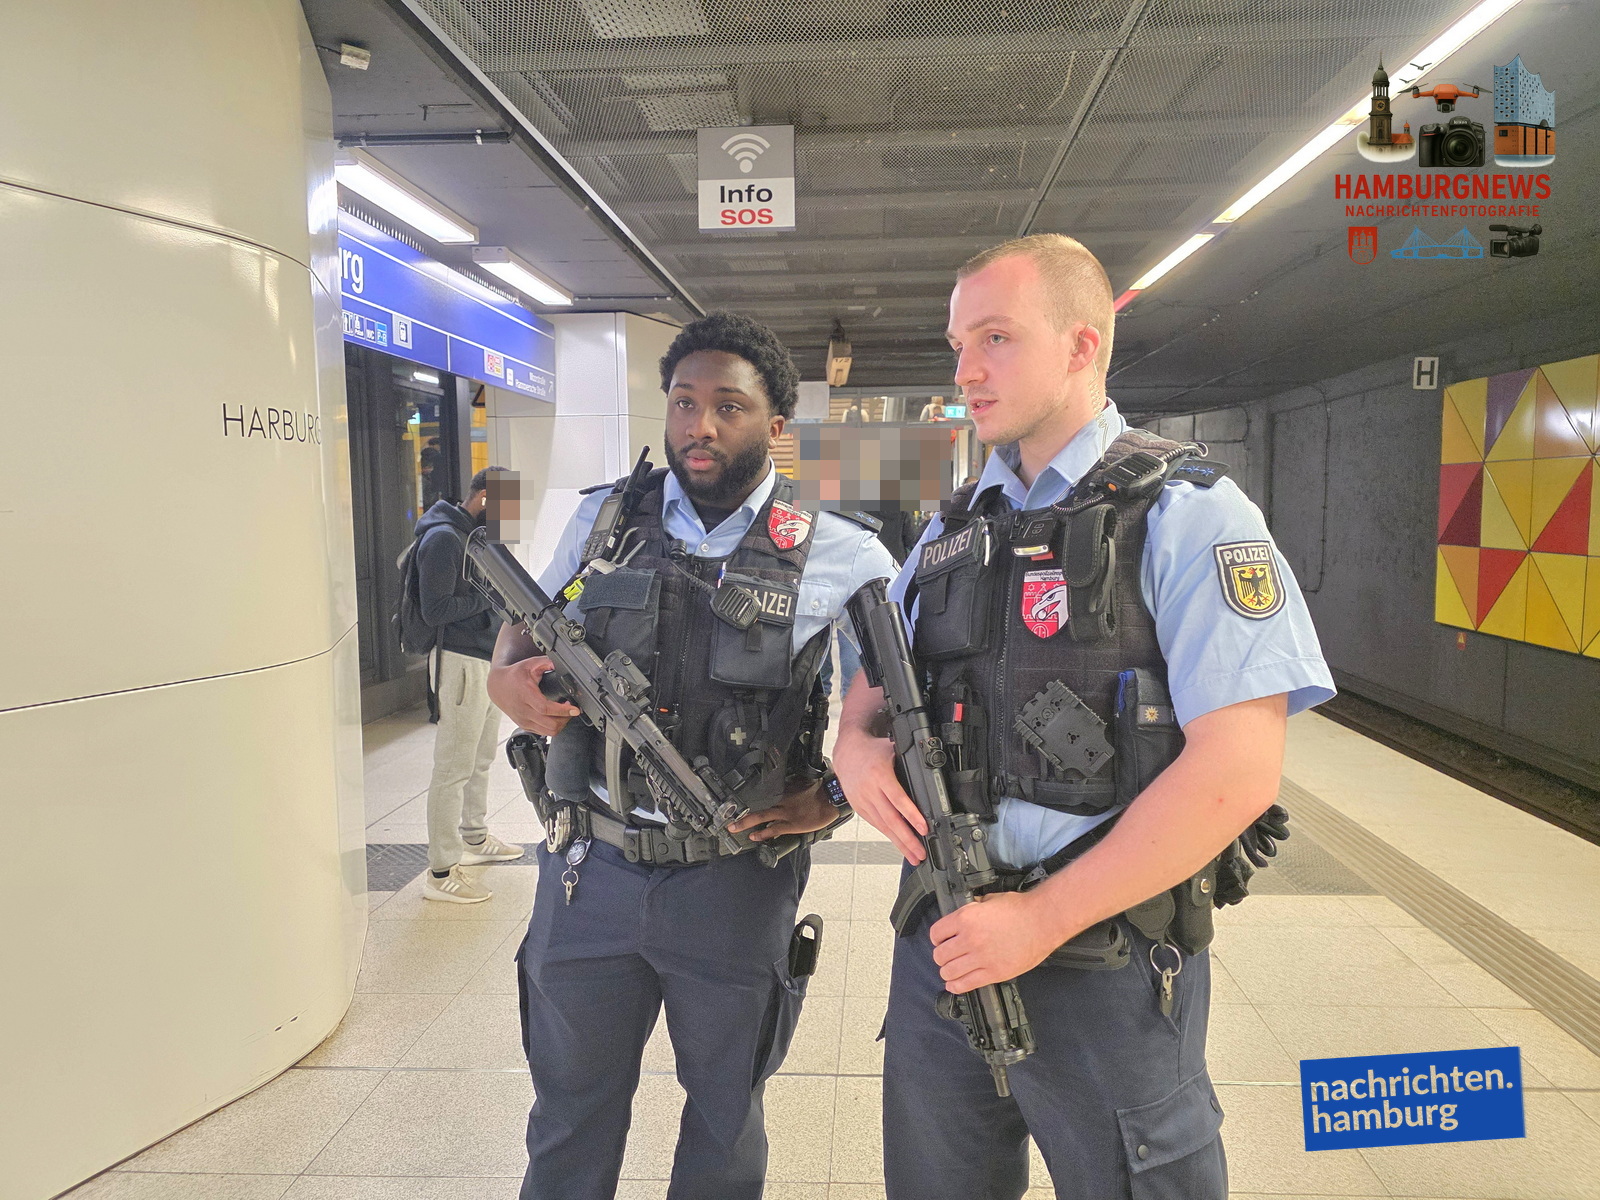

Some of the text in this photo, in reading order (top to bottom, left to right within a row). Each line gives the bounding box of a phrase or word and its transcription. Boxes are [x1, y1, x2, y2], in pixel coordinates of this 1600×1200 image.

[719, 184, 773, 203] Info
[720, 208, 774, 226] SOS
[1416, 360, 1435, 386] H
[222, 402, 320, 445] HARBURG
[922, 527, 973, 569] POLIZEI
[1222, 546, 1270, 565] POLIZEI
[746, 588, 792, 617] IZEI
